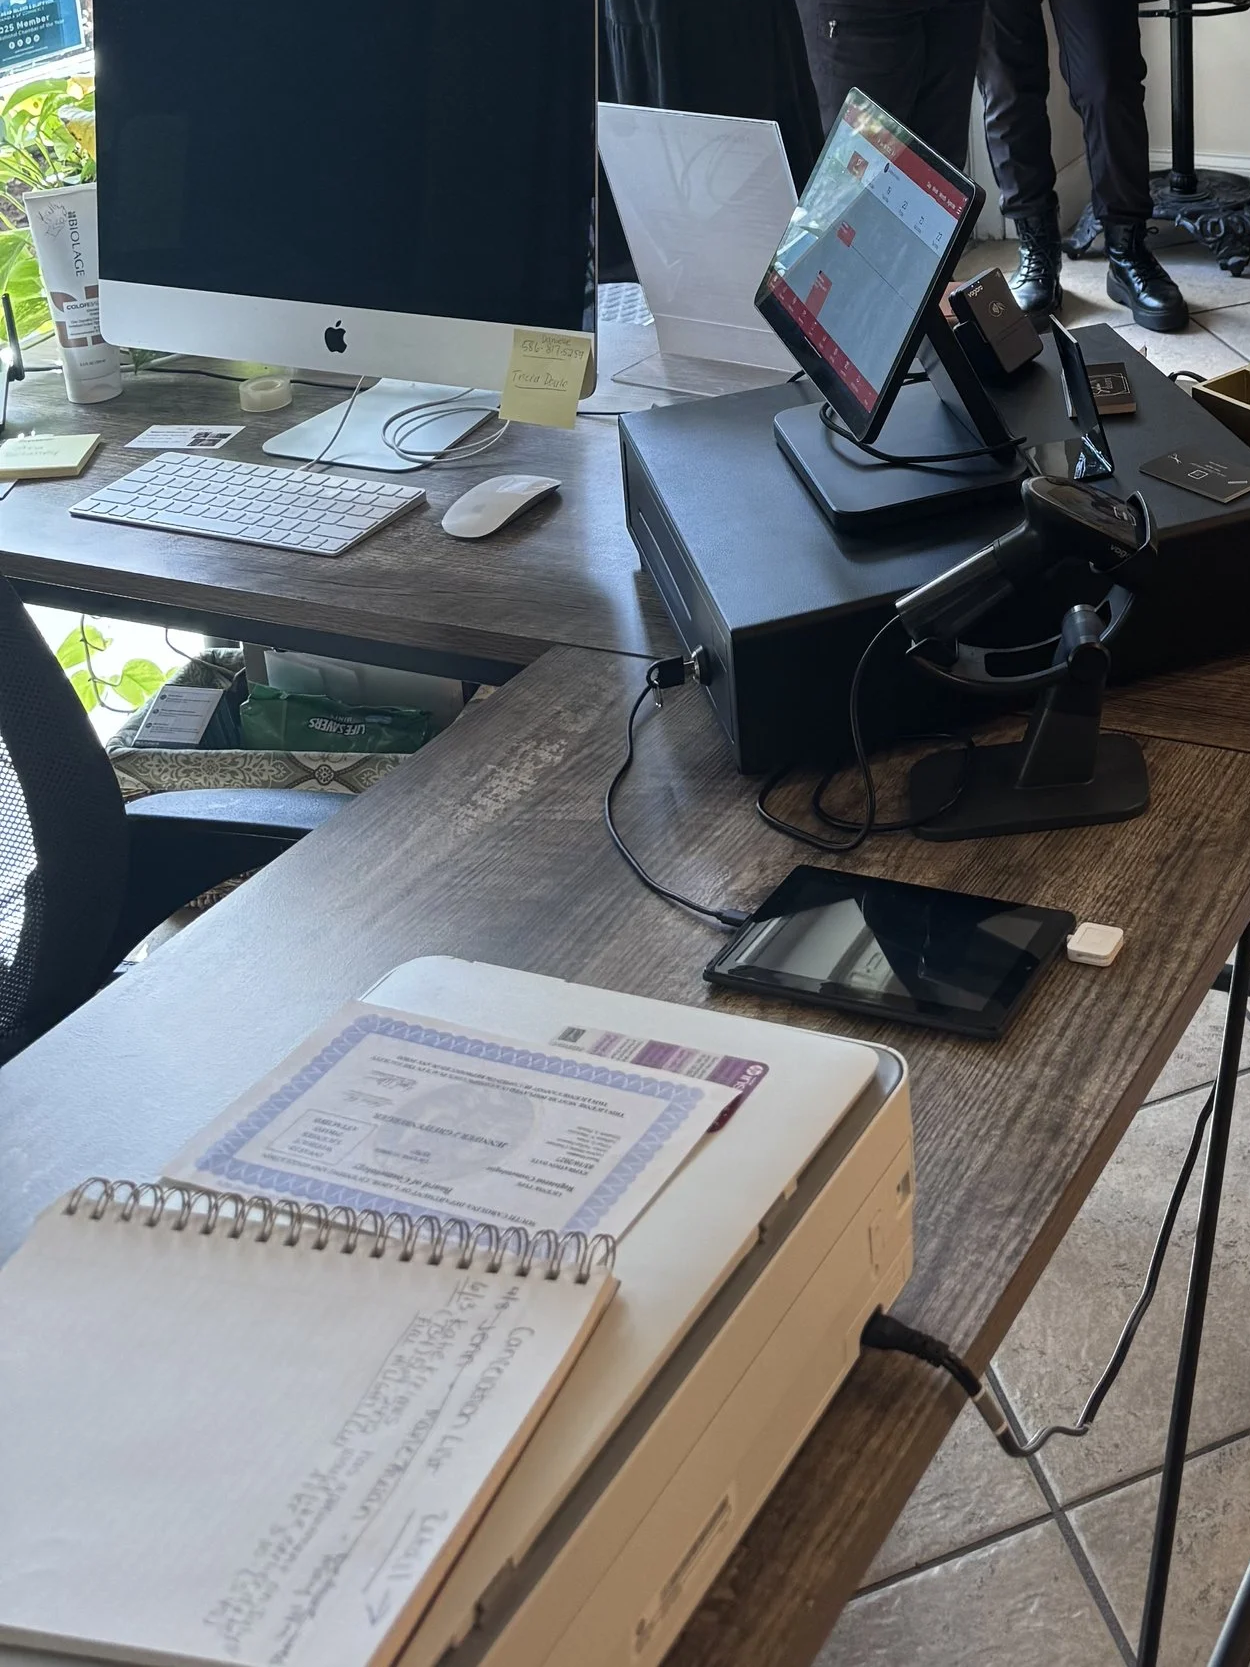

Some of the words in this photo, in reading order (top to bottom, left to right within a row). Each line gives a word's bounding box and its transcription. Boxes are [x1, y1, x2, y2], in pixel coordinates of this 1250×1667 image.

[16, 14, 50, 29] Member
[68, 218, 85, 277] BIOLAGE
[308, 717, 343, 733] SAVERS
[344, 724, 366, 736] LIFE
[460, 1134, 508, 1149] JENNIFER
[421, 1181, 453, 1195] Board
[536, 1177, 575, 1193] Registered
